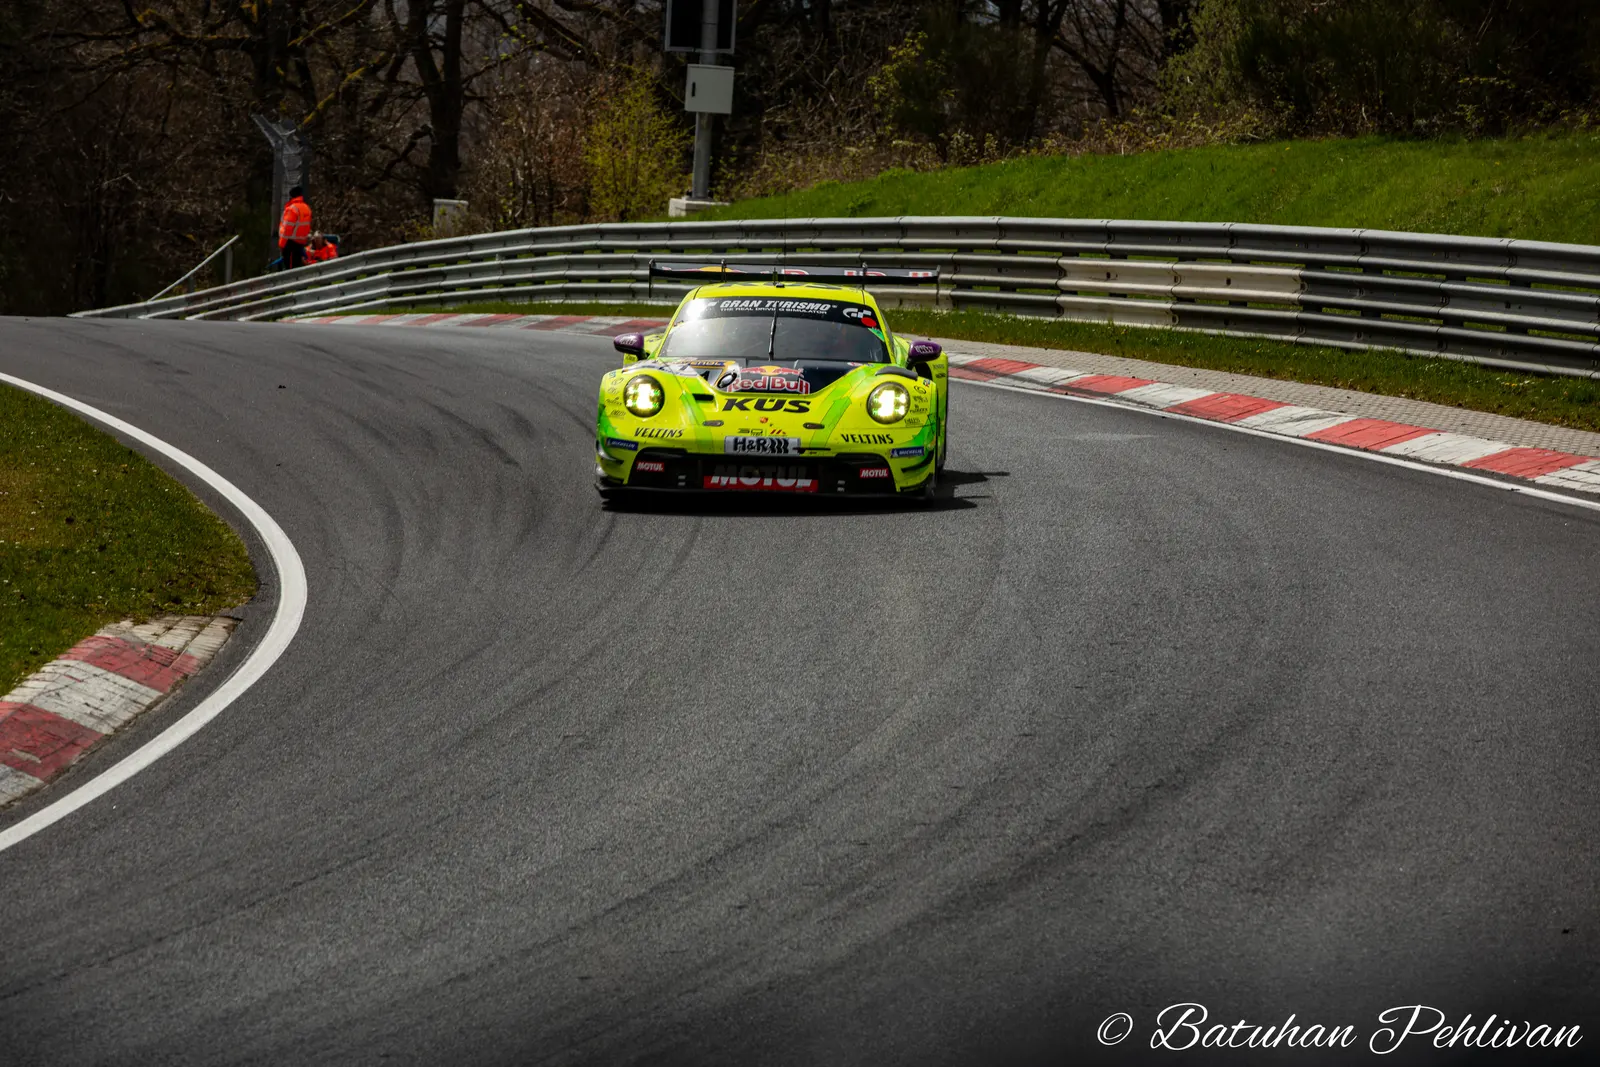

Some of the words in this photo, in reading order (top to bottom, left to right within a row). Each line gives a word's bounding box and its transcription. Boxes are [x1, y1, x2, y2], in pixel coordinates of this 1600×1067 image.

[719, 300, 760, 309] GRAN
[766, 300, 831, 311] TURISMO
[727, 376, 769, 393] Red
[769, 376, 811, 395] Bull
[634, 427, 685, 438] VELTINS
[840, 433, 894, 445] VELTINS
[636, 461, 664, 471] MOTUL
[710, 465, 812, 488] MOTUL
[860, 469, 888, 478] MOTUL
